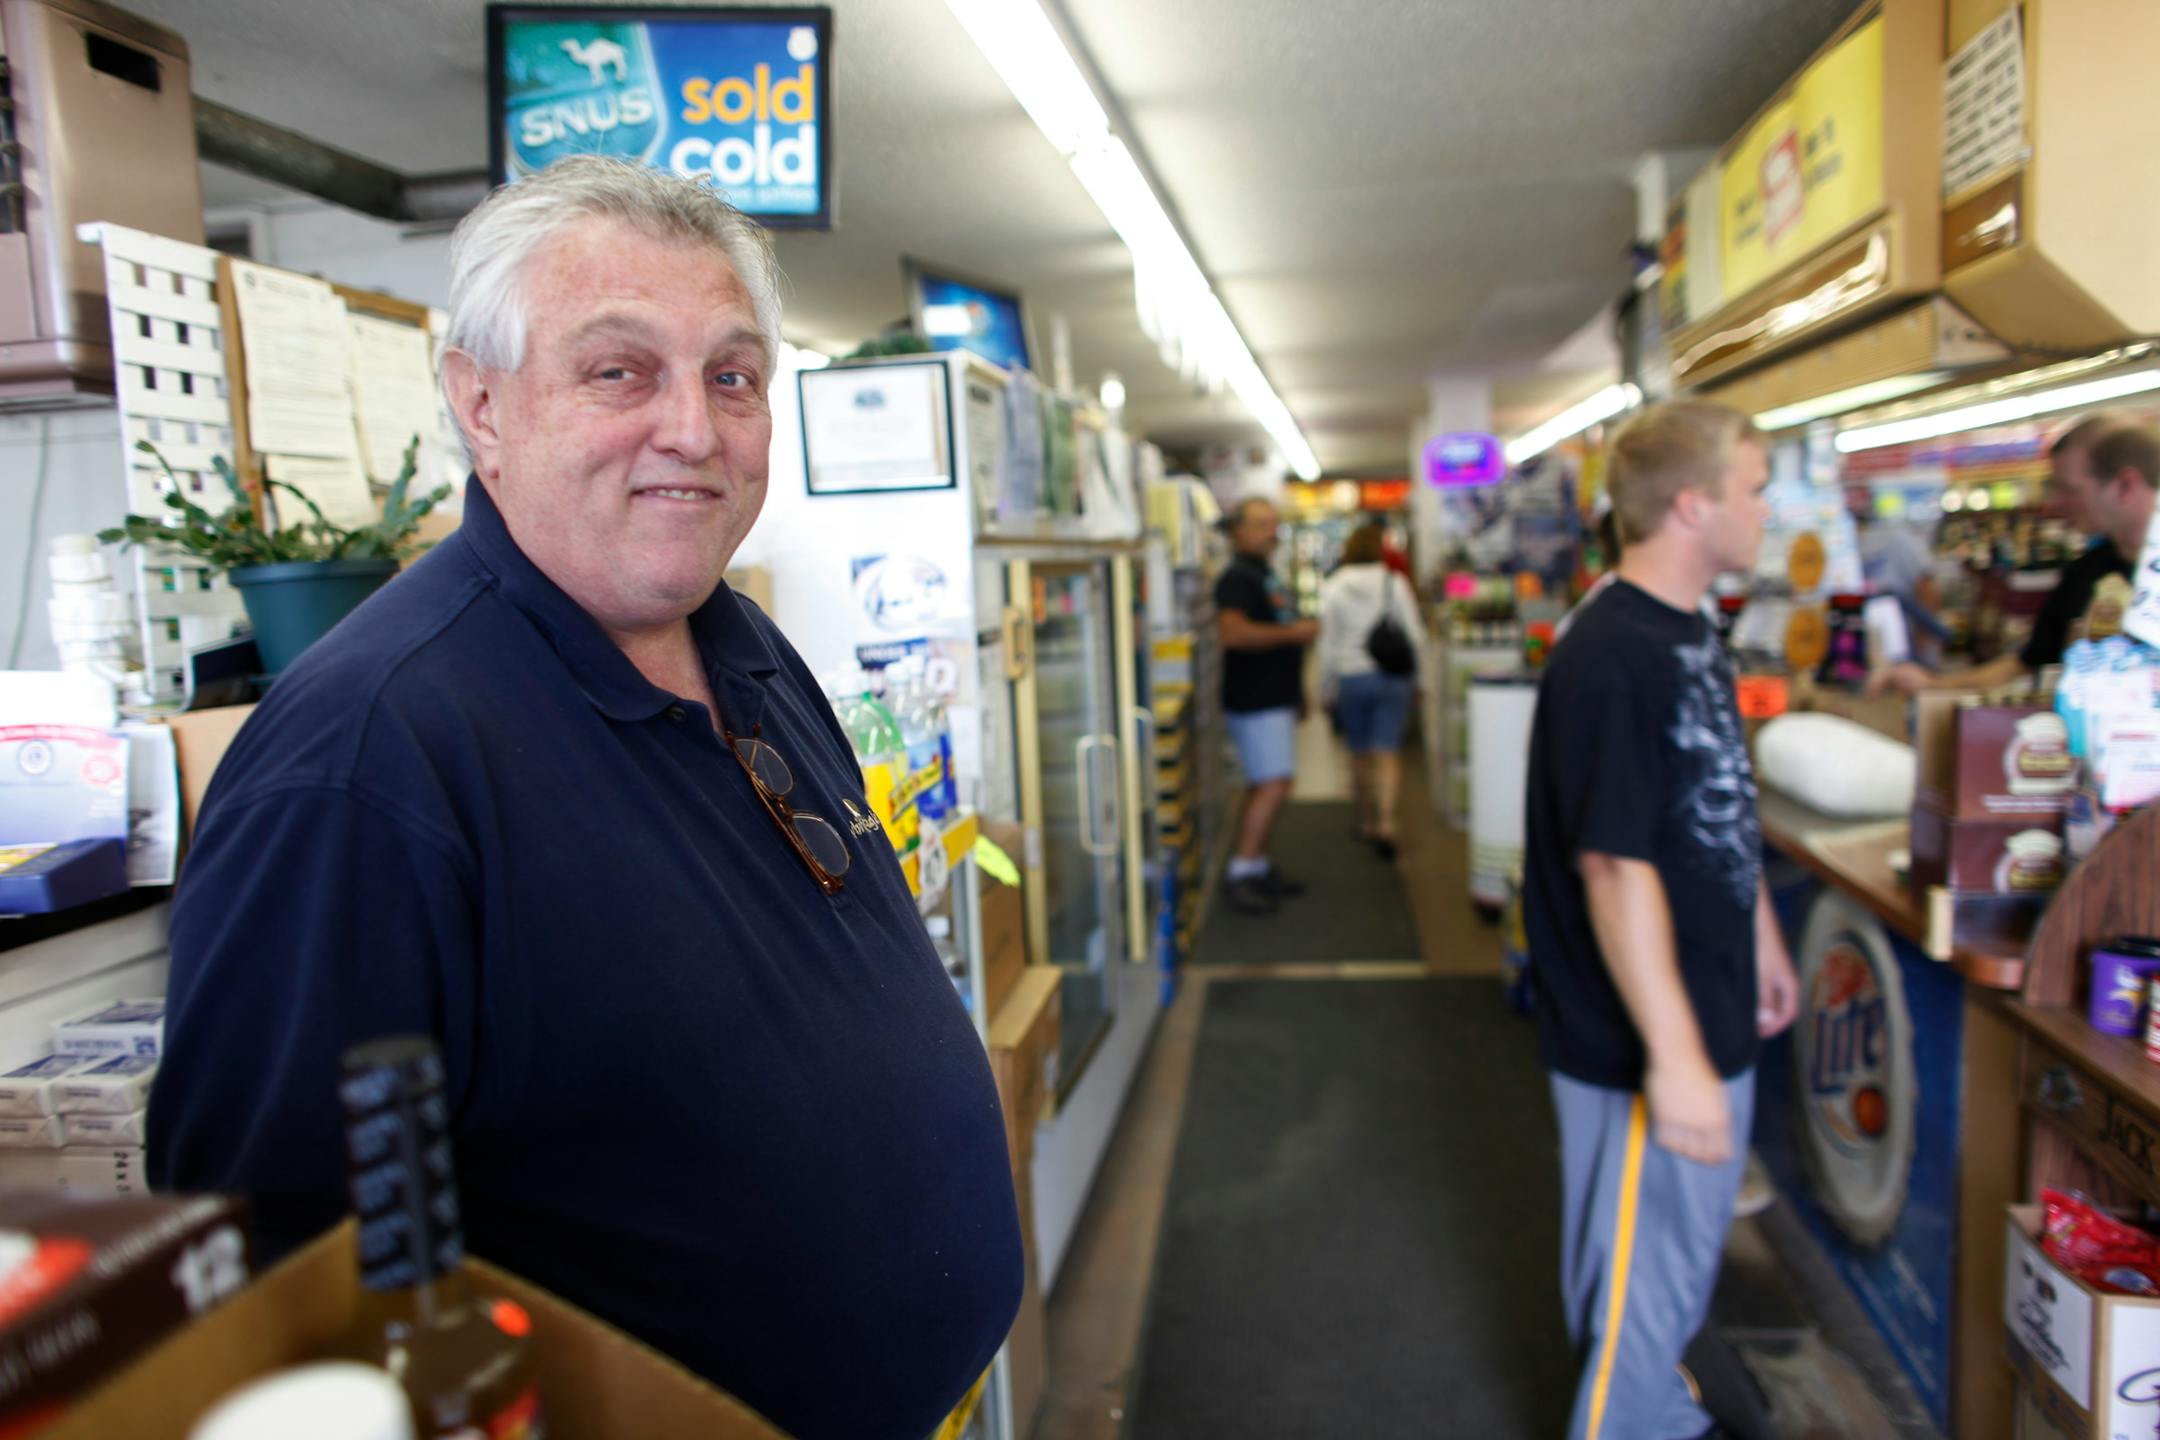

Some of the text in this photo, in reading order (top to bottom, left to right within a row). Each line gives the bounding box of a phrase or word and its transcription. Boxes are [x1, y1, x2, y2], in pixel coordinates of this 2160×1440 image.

[520, 88, 651, 147] SNUS
[682, 63, 815, 124] sold
[670, 123, 817, 185] cold
[1812, 997, 1888, 1095] Lite
[2097, 1098, 2157, 1175] JACK
